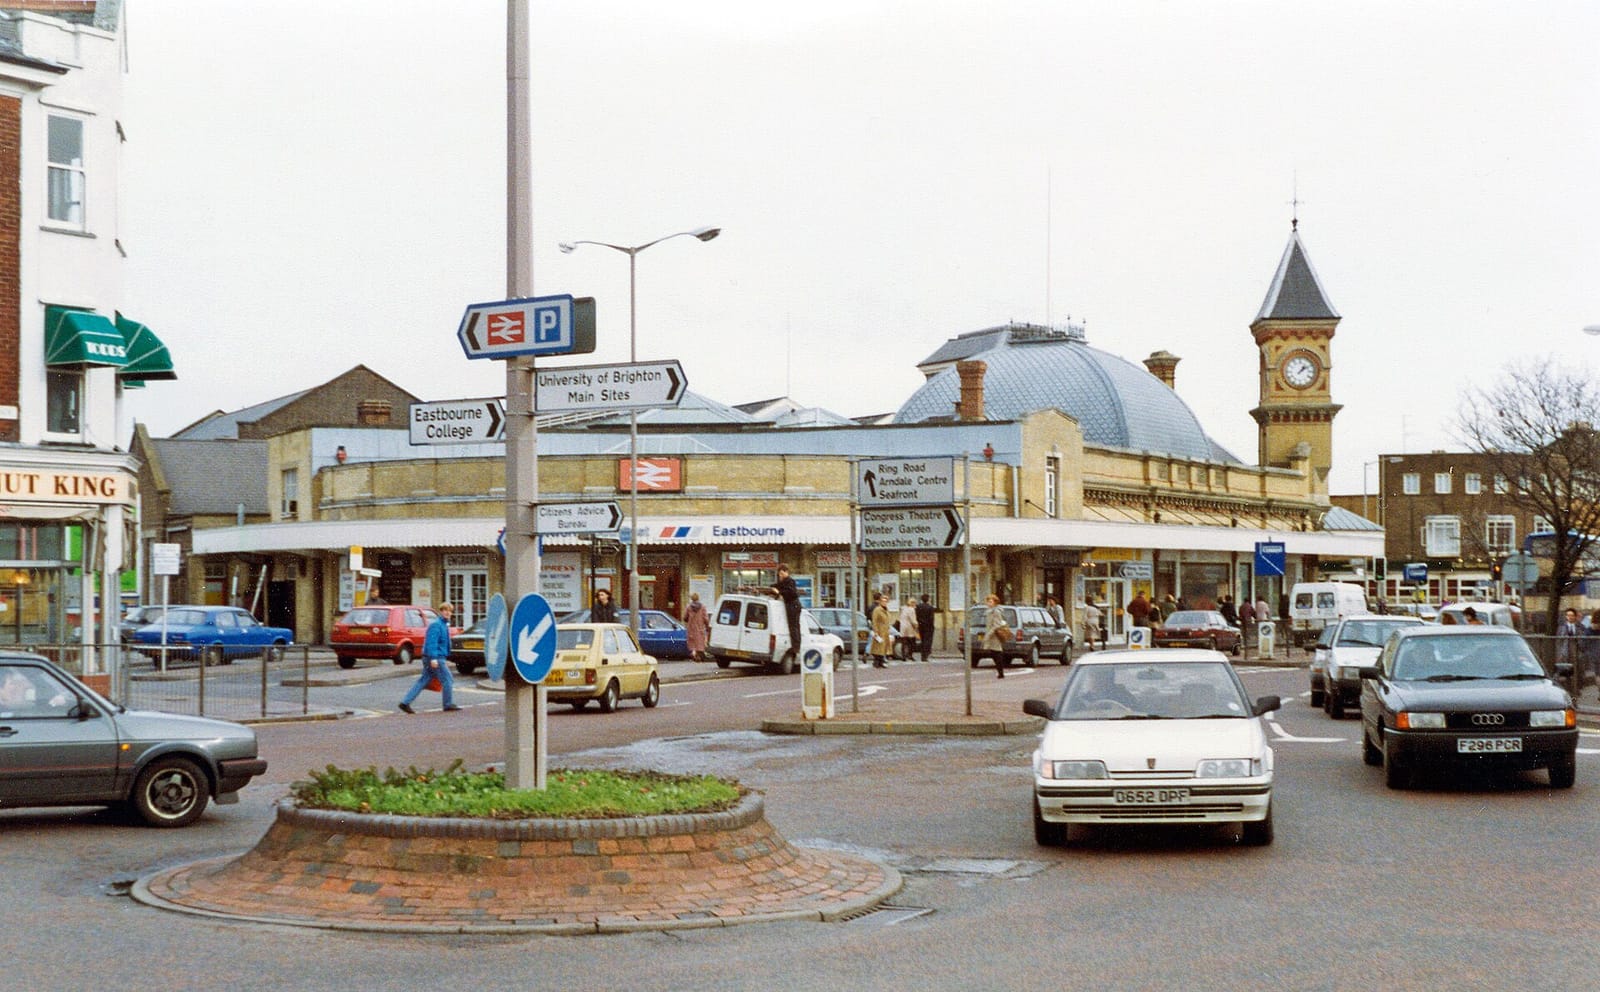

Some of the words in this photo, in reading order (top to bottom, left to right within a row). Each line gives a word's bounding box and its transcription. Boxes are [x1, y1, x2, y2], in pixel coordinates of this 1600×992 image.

[540, 310, 557, 340] P
[539, 374, 592, 387] University
[597, 371, 609, 384] of
[613, 370, 662, 384] Brighton
[567, 391, 595, 403] Main
[600, 389, 630, 401] Sites
[415, 408, 482, 422] Eastbourne
[426, 424, 473, 439] College
[878, 464, 898, 475] Ring
[903, 463, 926, 473] Road
[0, 472, 39, 494] UT
[53, 475, 116, 497] KING
[879, 476, 912, 486] Arndale
[917, 475, 947, 485] Centre
[879, 489, 918, 500] Seafront
[540, 507, 573, 517] Citizens
[577, 505, 606, 515] Advice
[863, 511, 904, 523] Congress
[907, 510, 942, 520] Theatre
[558, 520, 587, 529] Bureau
[864, 525, 893, 535] Winter
[898, 524, 931, 534] Garden
[712, 525, 785, 537] Eastbourne
[865, 537, 912, 548] Devonshire
[918, 537, 938, 546] Park
[1460, 740, 1493, 751] F296
[1495, 740, 1521, 750] PCR
[1116, 790, 1154, 803] D652
[1159, 790, 1188, 802] DPF
